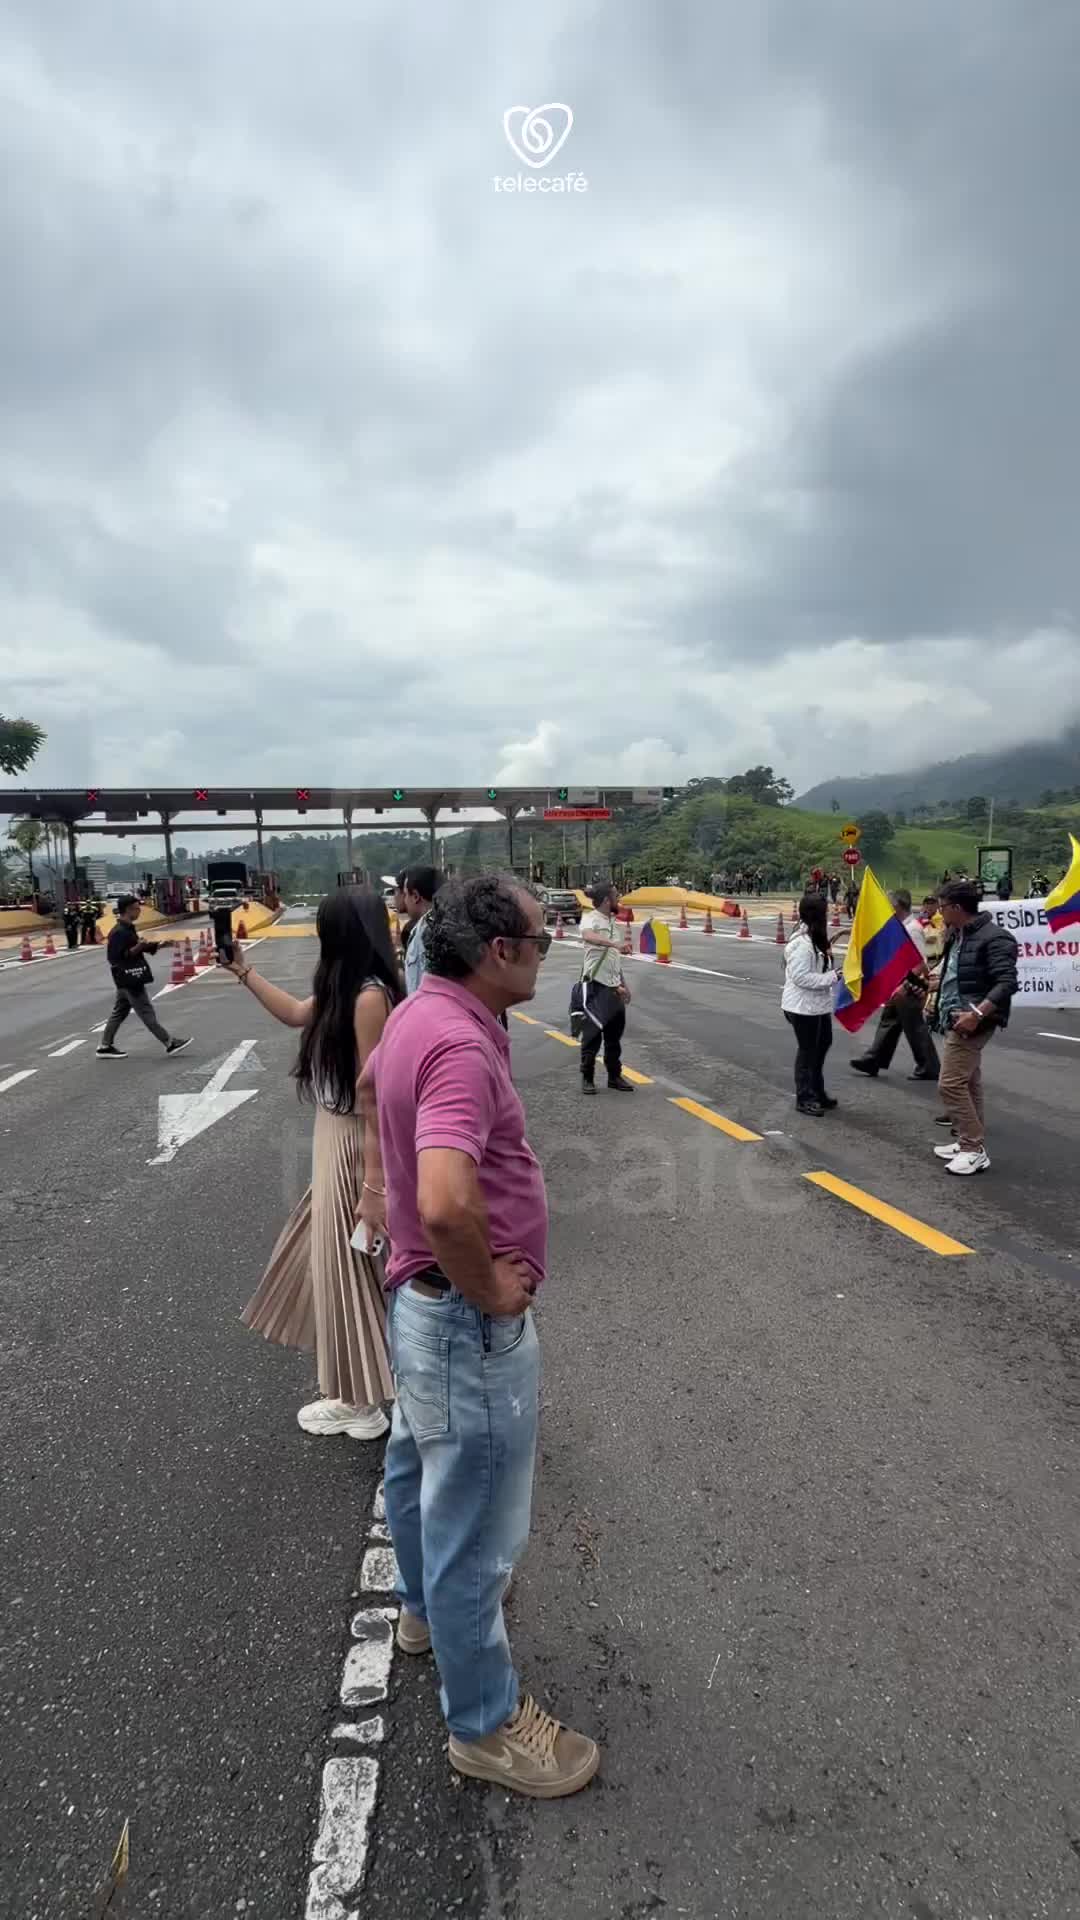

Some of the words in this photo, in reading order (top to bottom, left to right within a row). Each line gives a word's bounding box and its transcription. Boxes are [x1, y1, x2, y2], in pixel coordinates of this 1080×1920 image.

[996, 905, 1048, 929] ESIDE
[1017, 941, 1080, 957] ERACRU
[1017, 976, 1054, 992] CCIÓN
